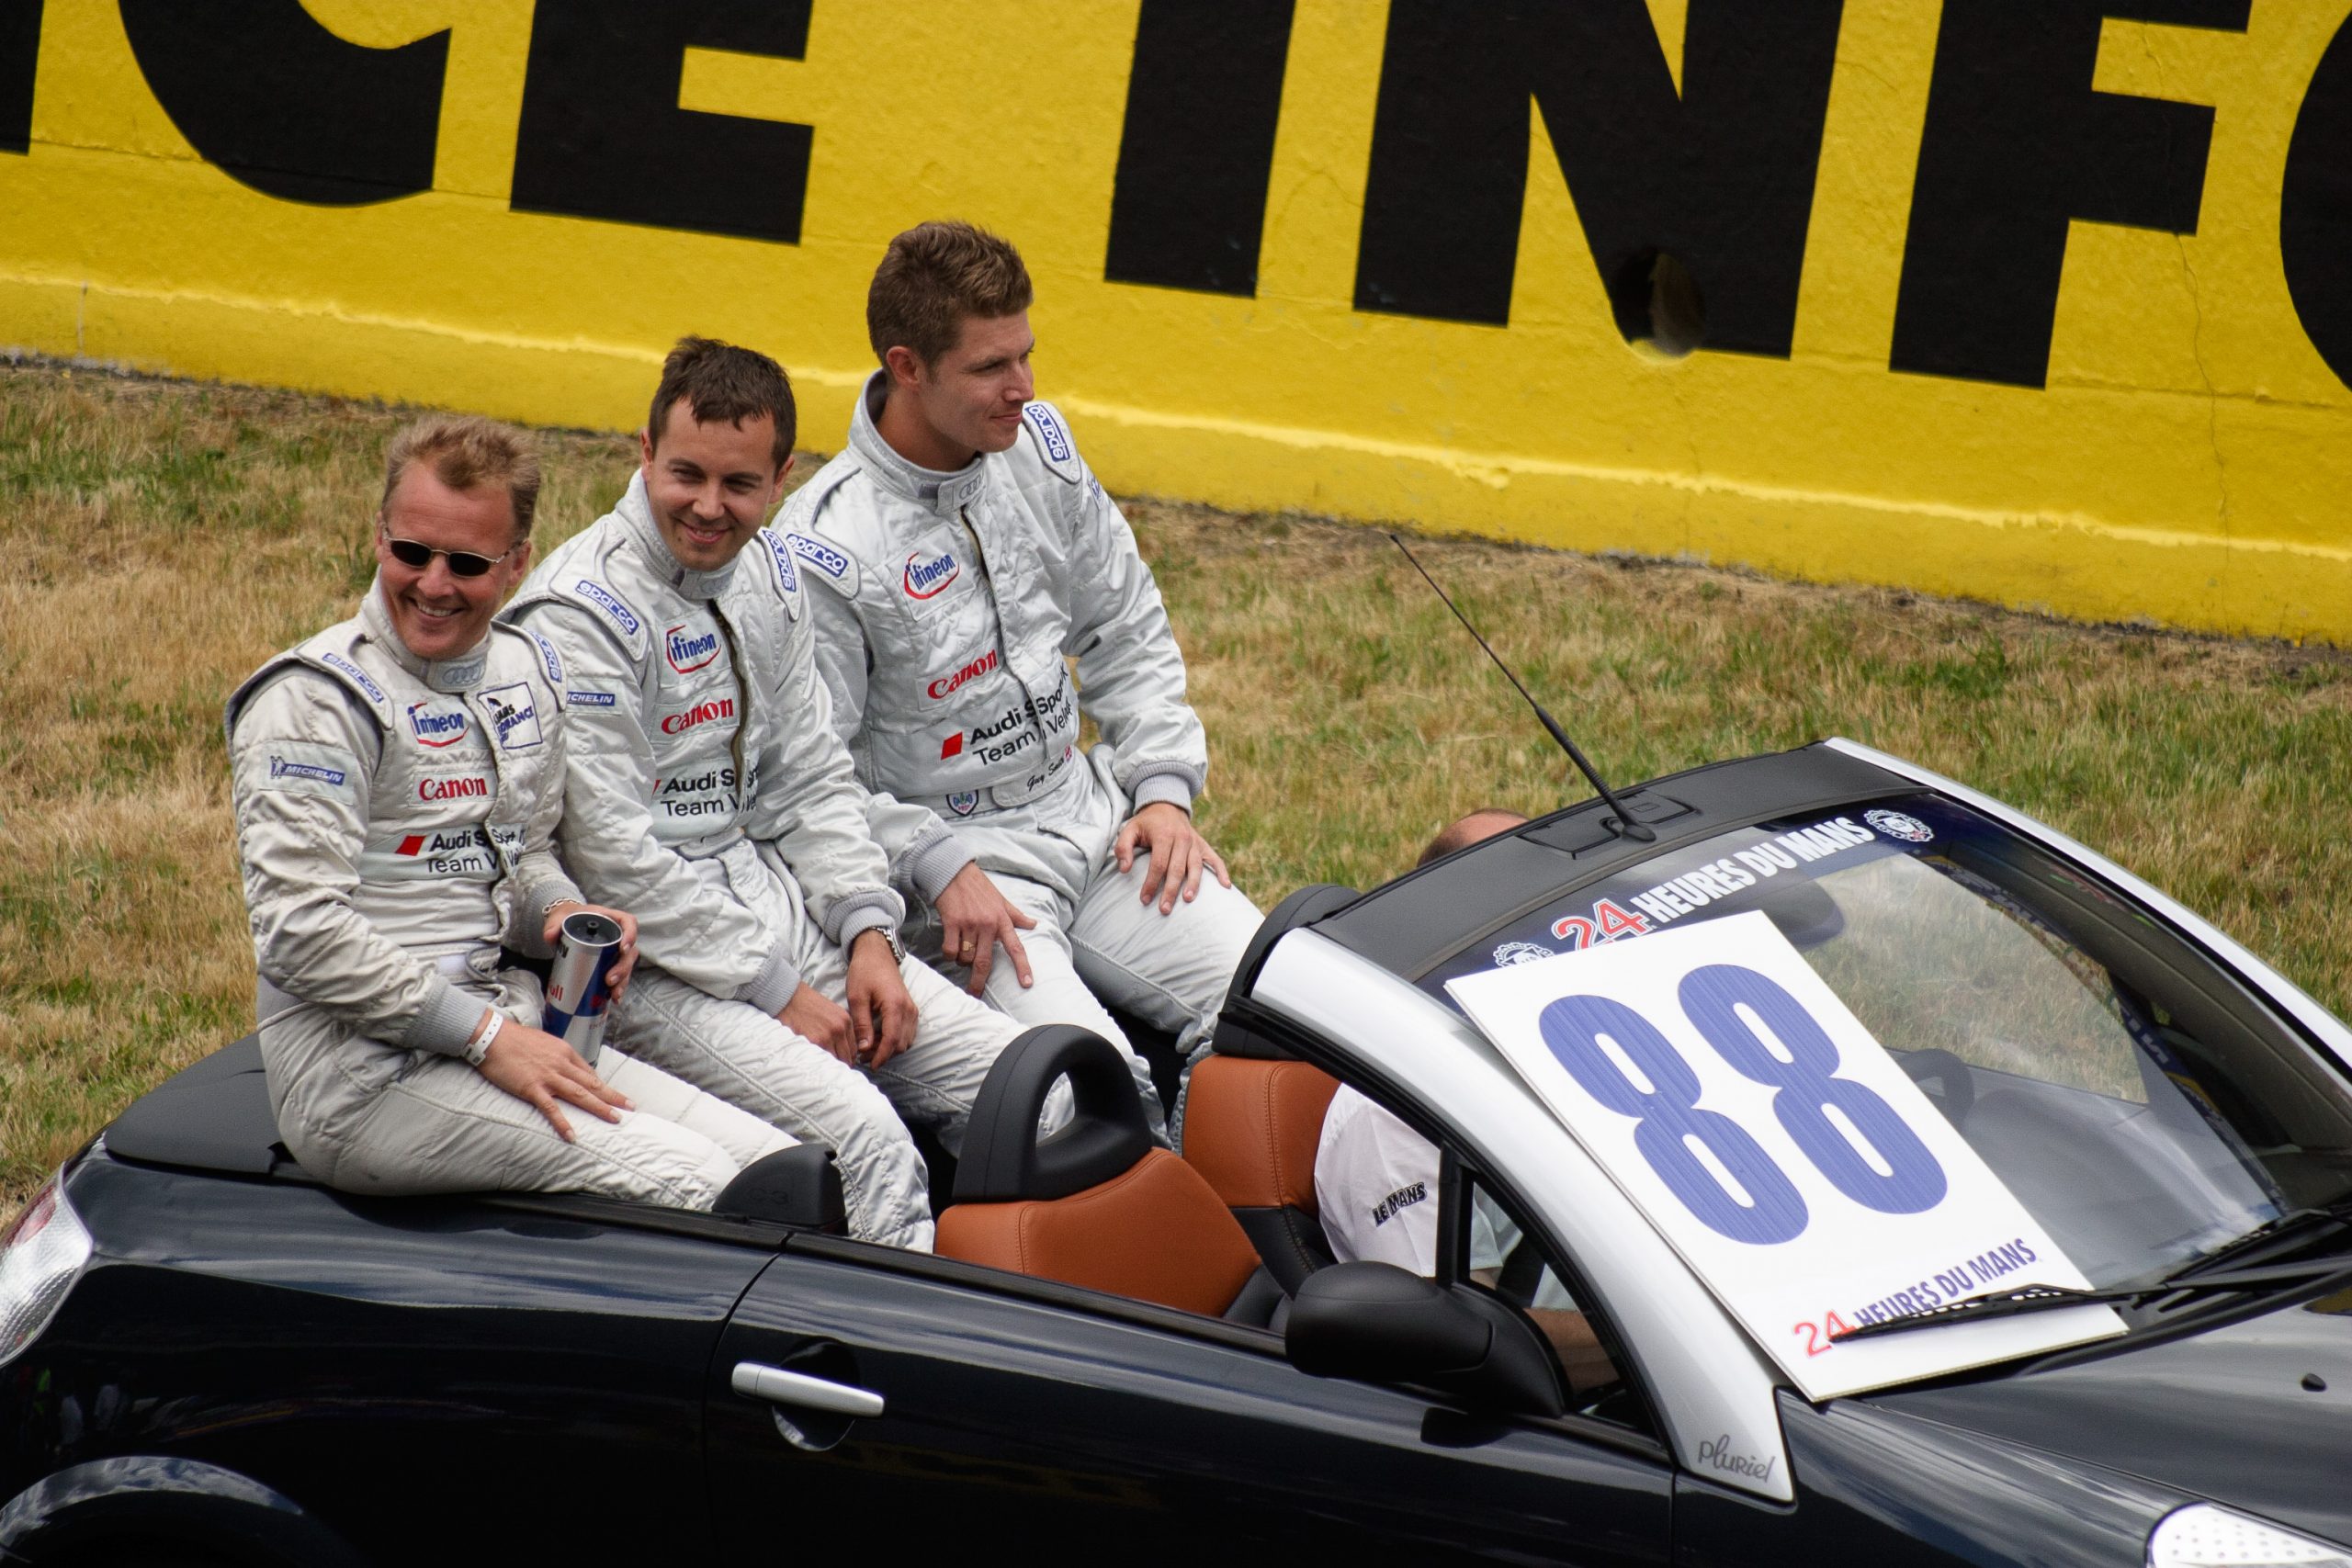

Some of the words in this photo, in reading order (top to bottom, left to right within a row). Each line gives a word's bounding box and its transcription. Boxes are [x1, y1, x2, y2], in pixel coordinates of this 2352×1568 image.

[577, 581, 636, 631] sparco
[928, 649, 997, 699] Canon
[662, 698, 734, 735] Canon
[970, 707, 1023, 746] Audi
[973, 730, 1036, 766] Team
[285, 765, 343, 782] MICHELIN
[419, 778, 488, 801] Canon
[662, 771, 717, 795] Audi
[660, 799, 725, 817] Team
[429, 830, 471, 852] Audi
[426, 857, 482, 873] Team
[1551, 897, 1656, 952] 24
[1629, 854, 1758, 924] HEURES
[1734, 837, 1798, 878] DU
[1777, 817, 1876, 863] MANS
[1540, 964, 1948, 1246] 88
[1372, 1201, 1390, 1228] LE
[1385, 1181, 1428, 1217] MANS
[1794, 1309, 1858, 1357] 24
[1933, 1259, 1975, 1299] DU
[1967, 1238, 2037, 1283] MANS
